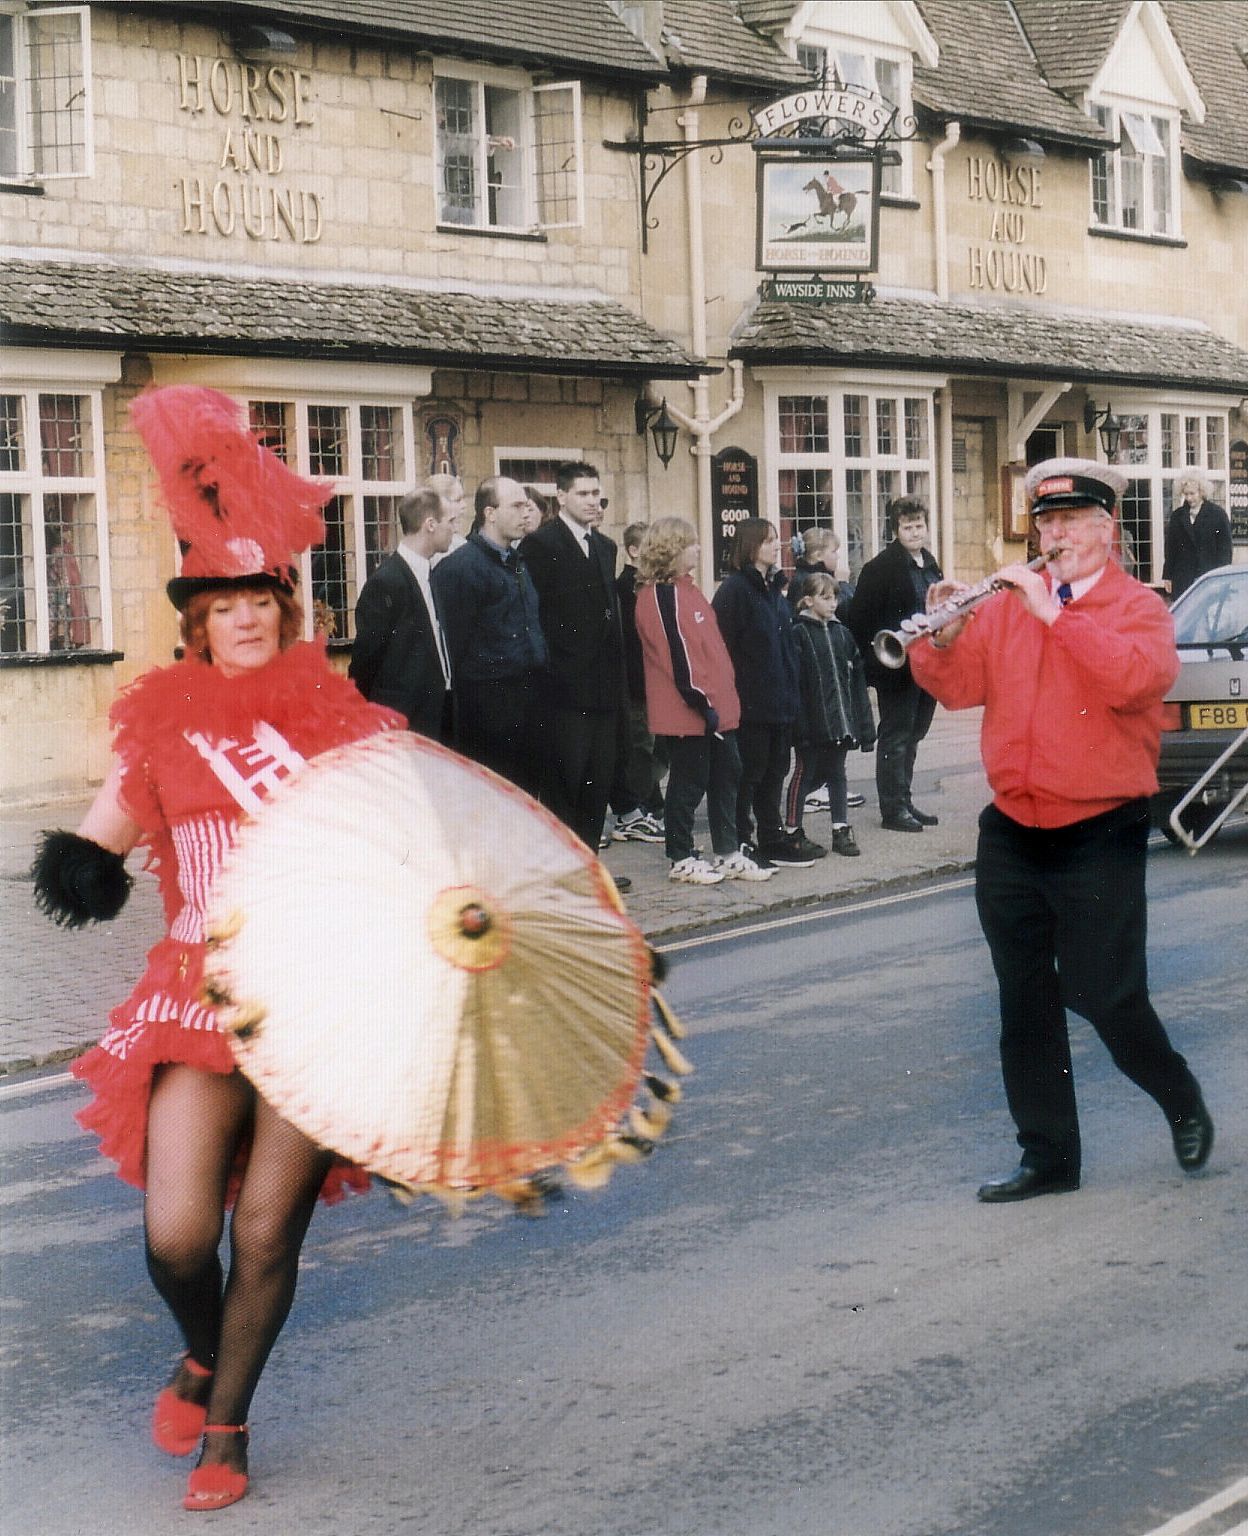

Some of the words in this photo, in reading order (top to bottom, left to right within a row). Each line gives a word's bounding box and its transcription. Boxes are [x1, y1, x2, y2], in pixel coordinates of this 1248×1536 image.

[176, 53, 315, 127] HORSE
[764, 93, 884, 127] FLOWERS
[220, 128, 284, 176] AND
[967, 156, 1044, 209] HORSE
[180, 176, 323, 244] HOUND
[989, 210, 1025, 245] AND
[765, 248, 808, 261] HORSE
[818, 248, 869, 261] HOUND
[968, 247, 1048, 295] HOUND
[775, 284, 824, 297] WAYSIDE
[826, 284, 856, 298] INNS
[1229, 484, 1248, 495] GOOD
[1230, 496, 1248, 507] FOOD
[721, 509, 750, 522] GOOD
[1199, 707, 1238, 726] F88
